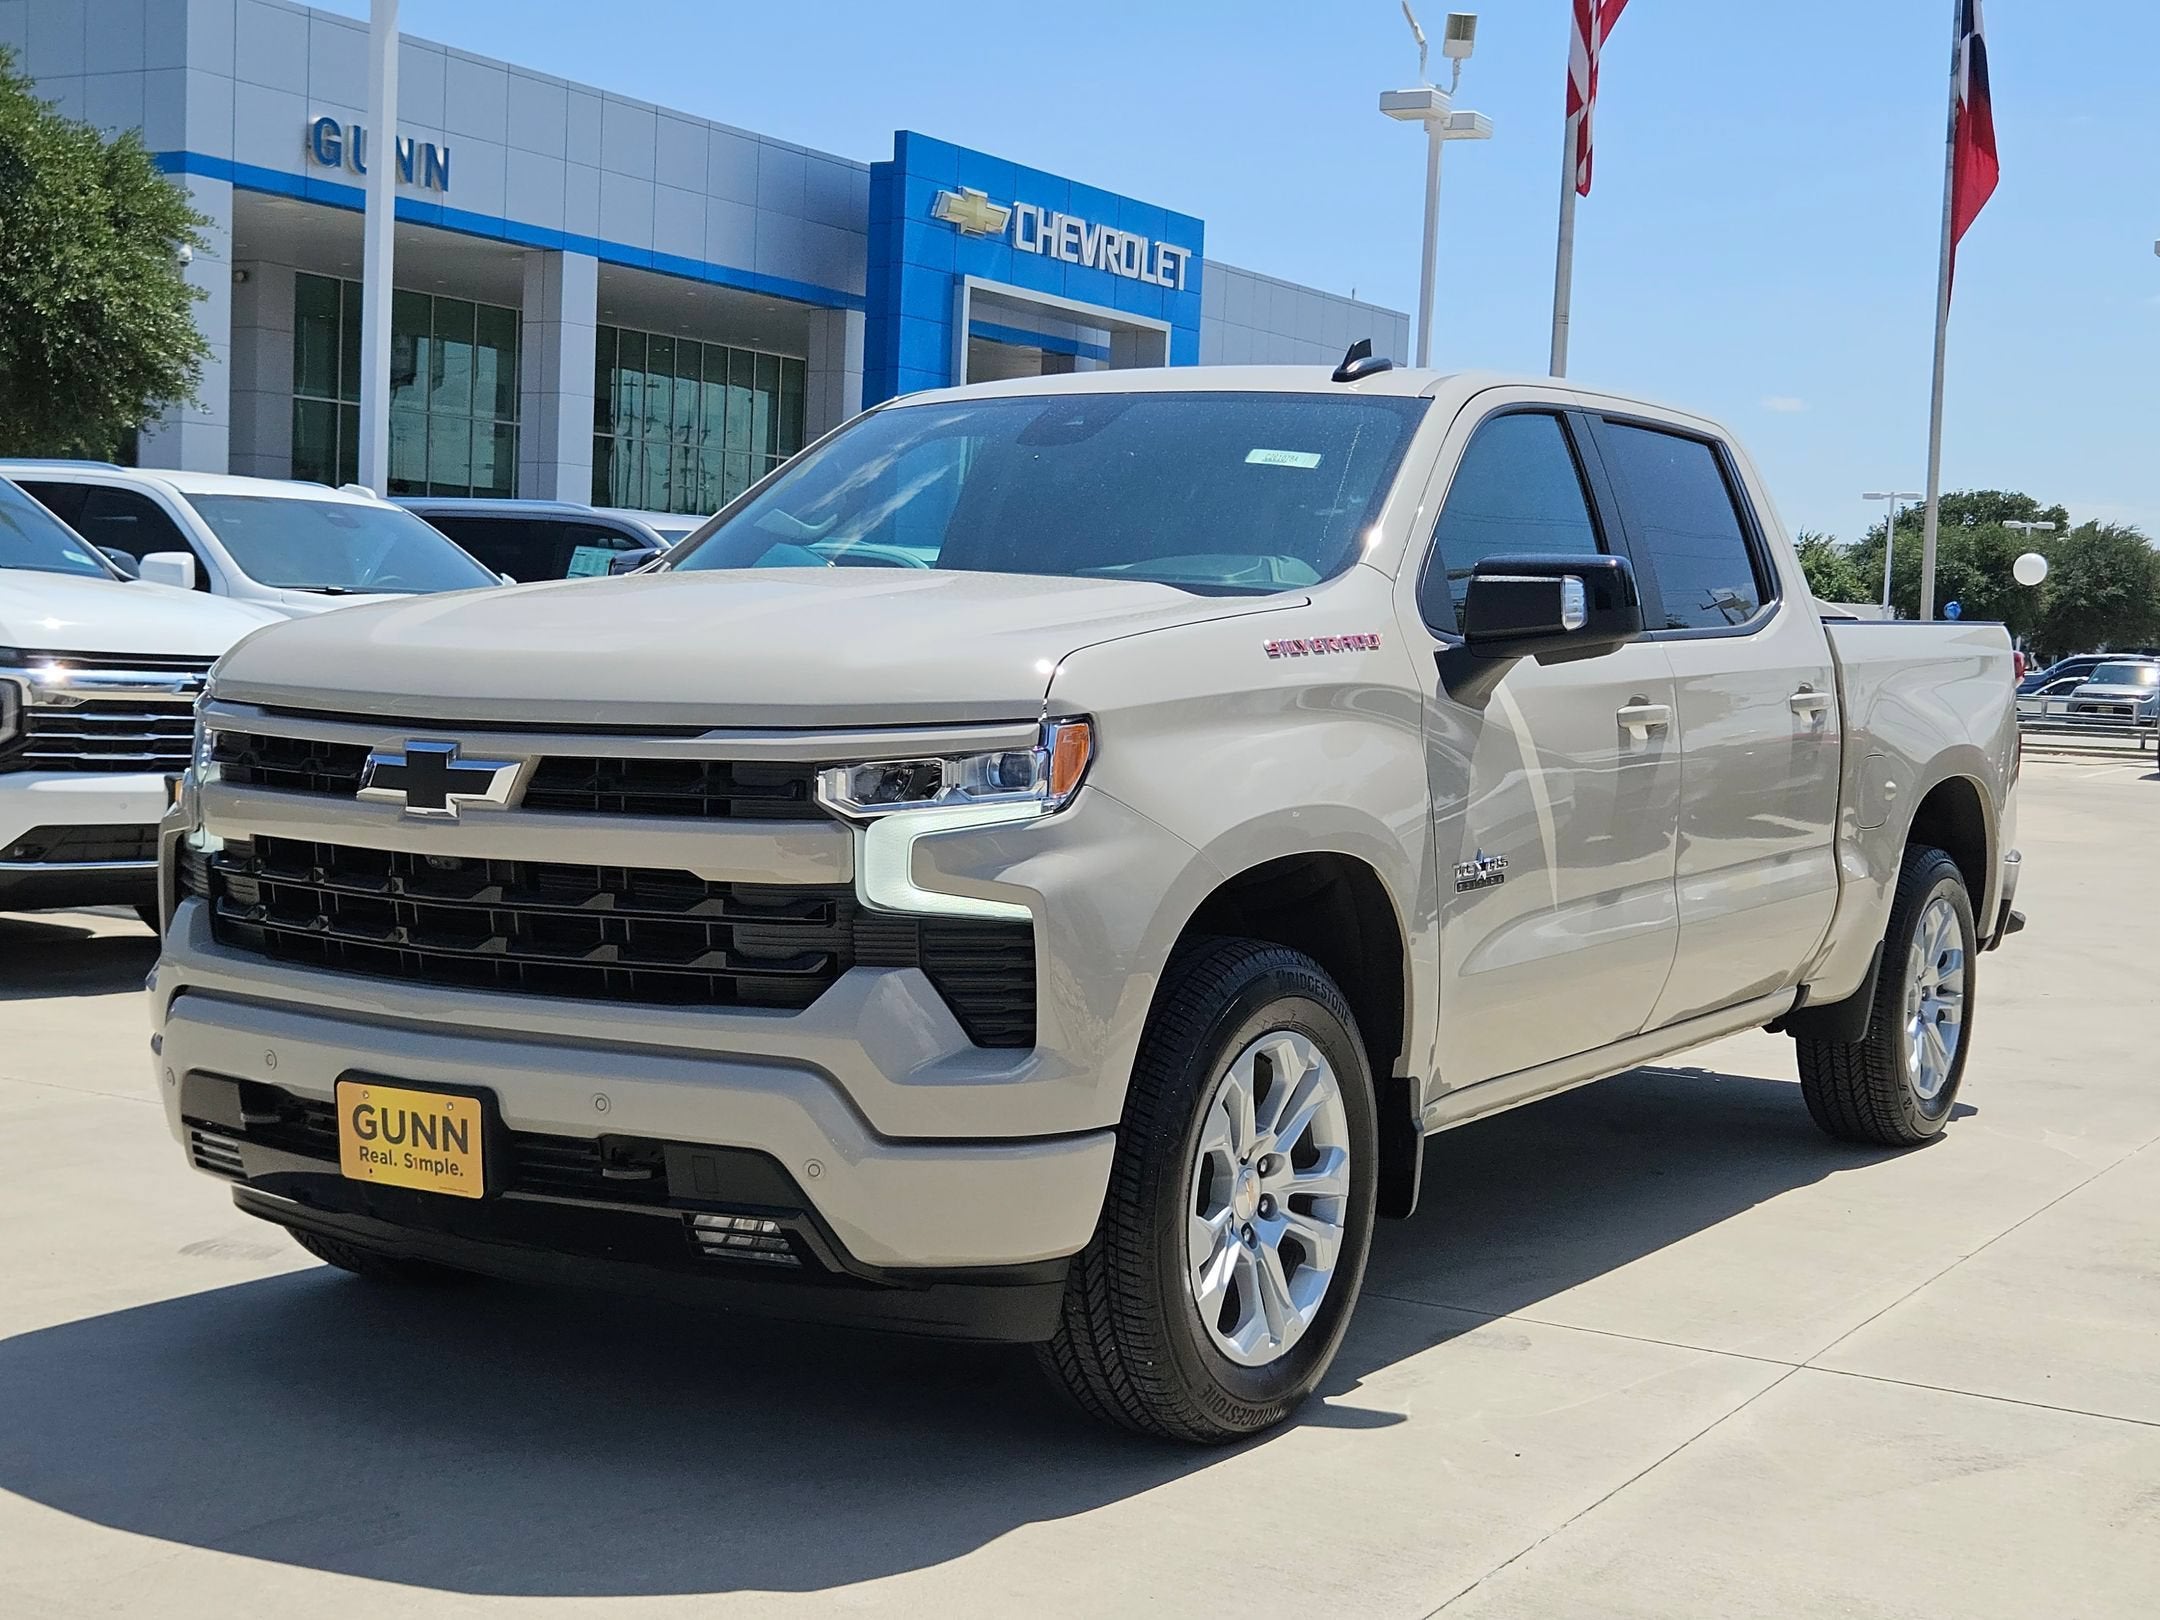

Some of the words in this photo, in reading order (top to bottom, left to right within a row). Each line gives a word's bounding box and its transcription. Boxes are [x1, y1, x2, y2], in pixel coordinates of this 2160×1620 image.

[1013, 201, 1191, 291] CHEVROLET
[1263, 633, 1381, 658] SILVERADO
[352, 1103, 468, 1155] GUNN
[359, 1145, 398, 1167] Real.
